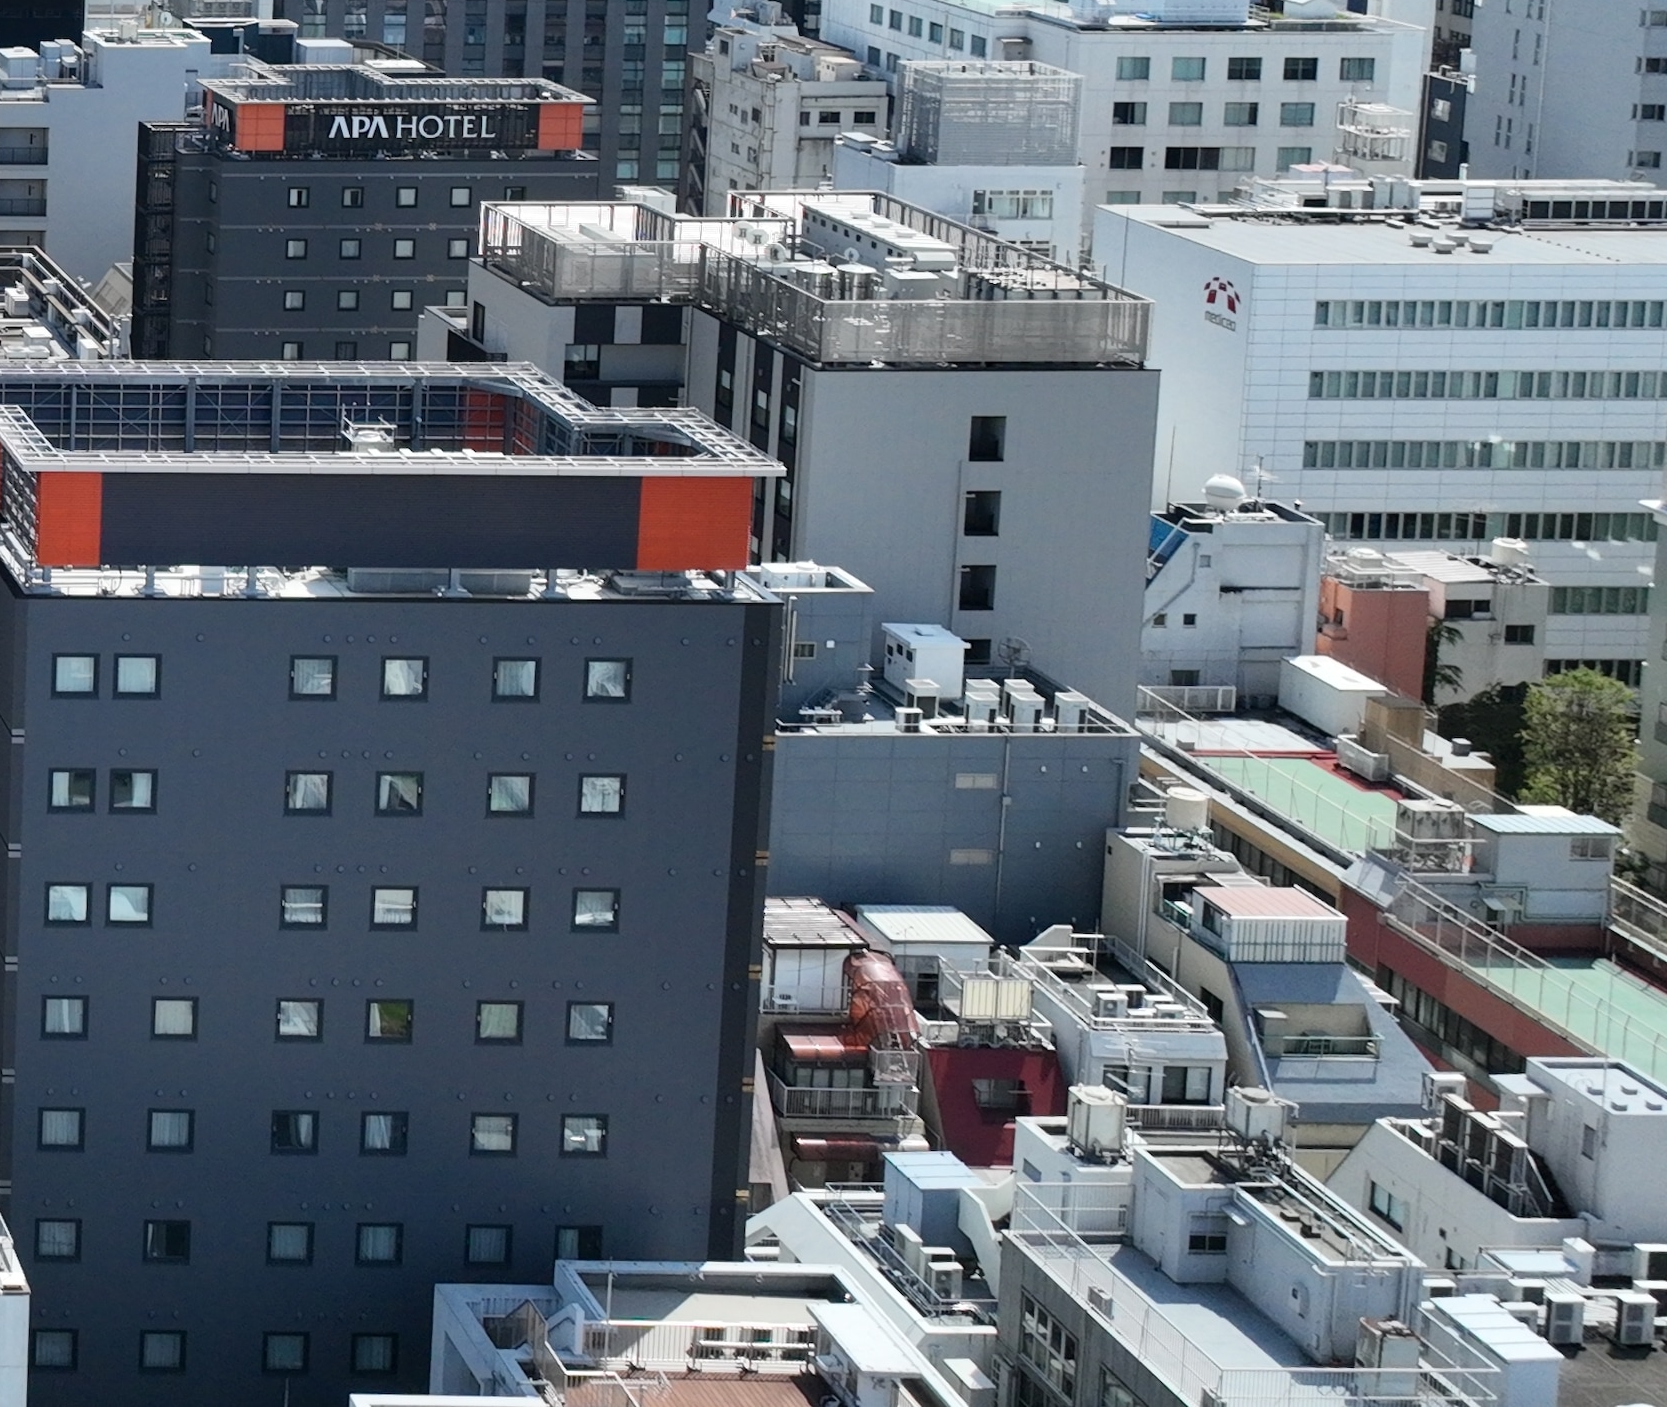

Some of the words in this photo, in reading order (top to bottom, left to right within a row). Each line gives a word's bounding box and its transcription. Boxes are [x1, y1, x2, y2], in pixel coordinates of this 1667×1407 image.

[211, 103, 230, 133] APA
[328, 115, 389, 139] APA
[396, 115, 496, 139] HOTEL
